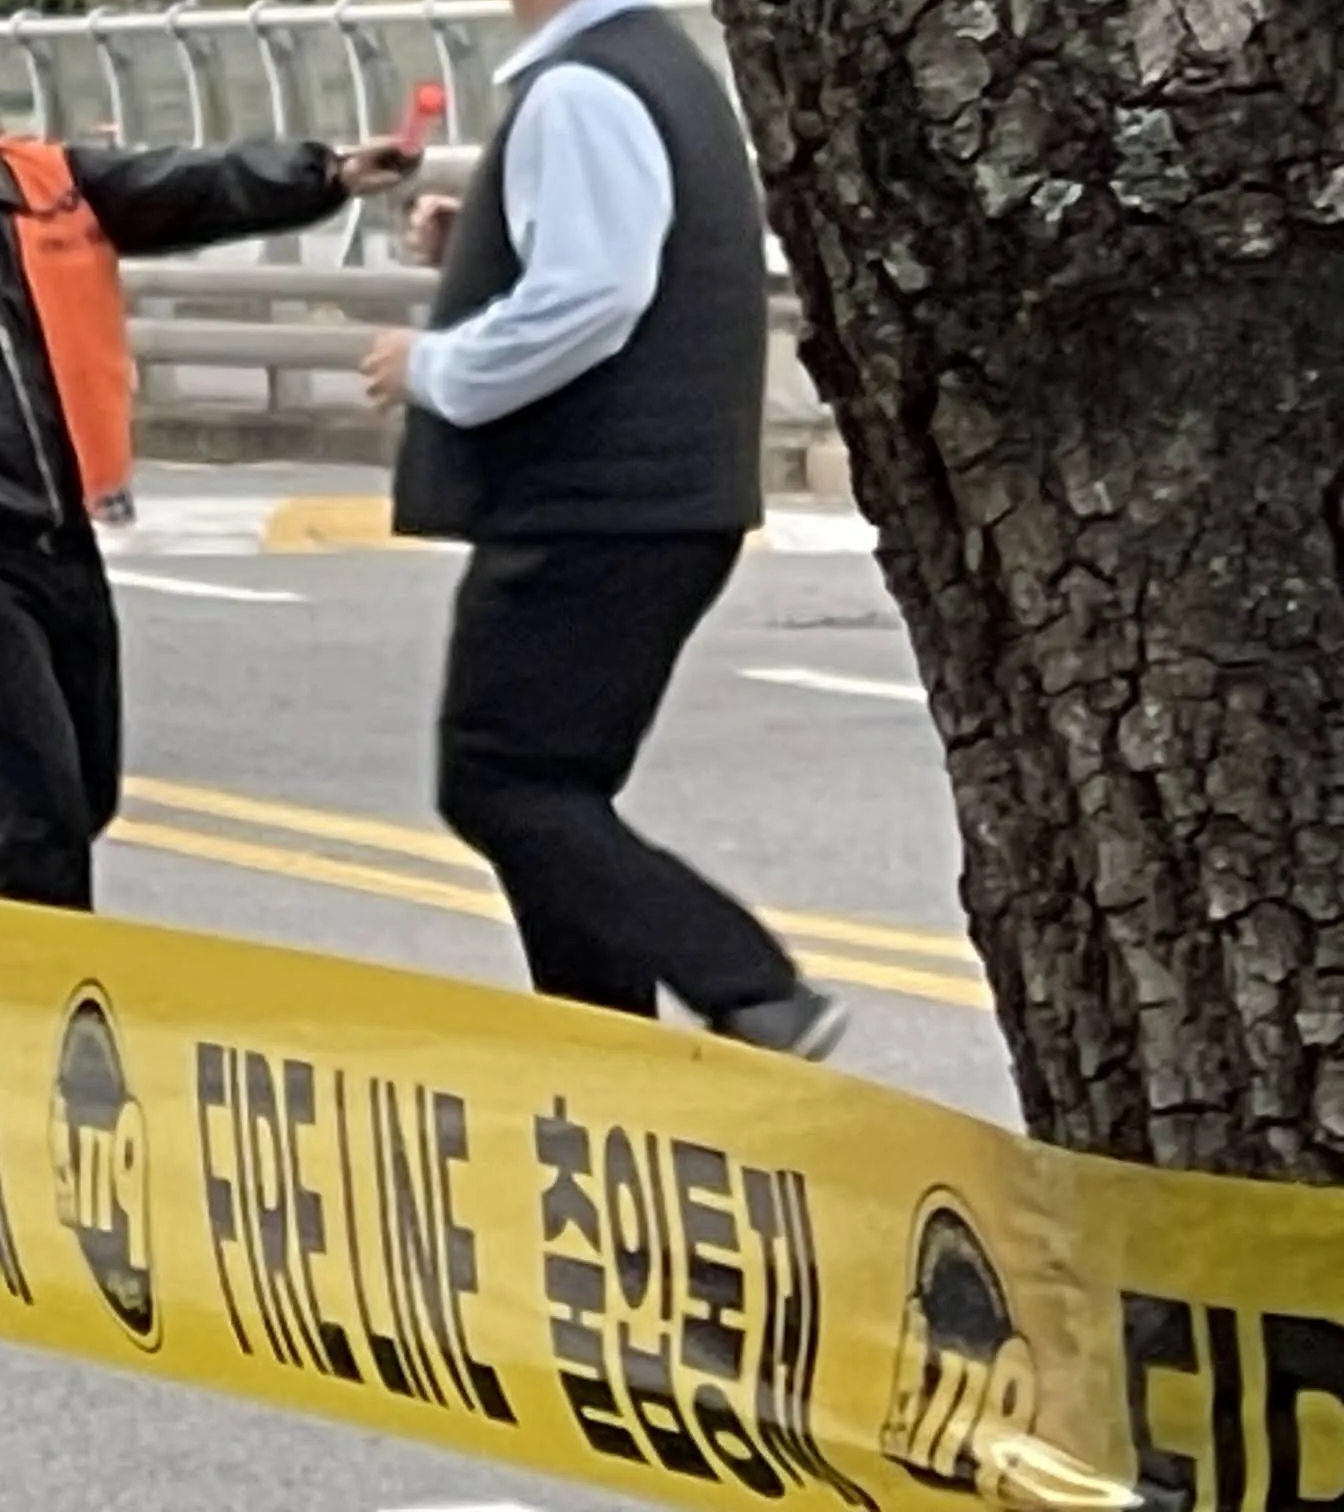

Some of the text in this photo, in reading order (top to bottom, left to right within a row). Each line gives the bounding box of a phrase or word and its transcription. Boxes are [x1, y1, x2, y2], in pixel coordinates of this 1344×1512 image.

[196, 1041, 366, 1385] FIRE
[334, 1068, 519, 1427] LINE
[533, 1094, 880, 1512] 출입통제
